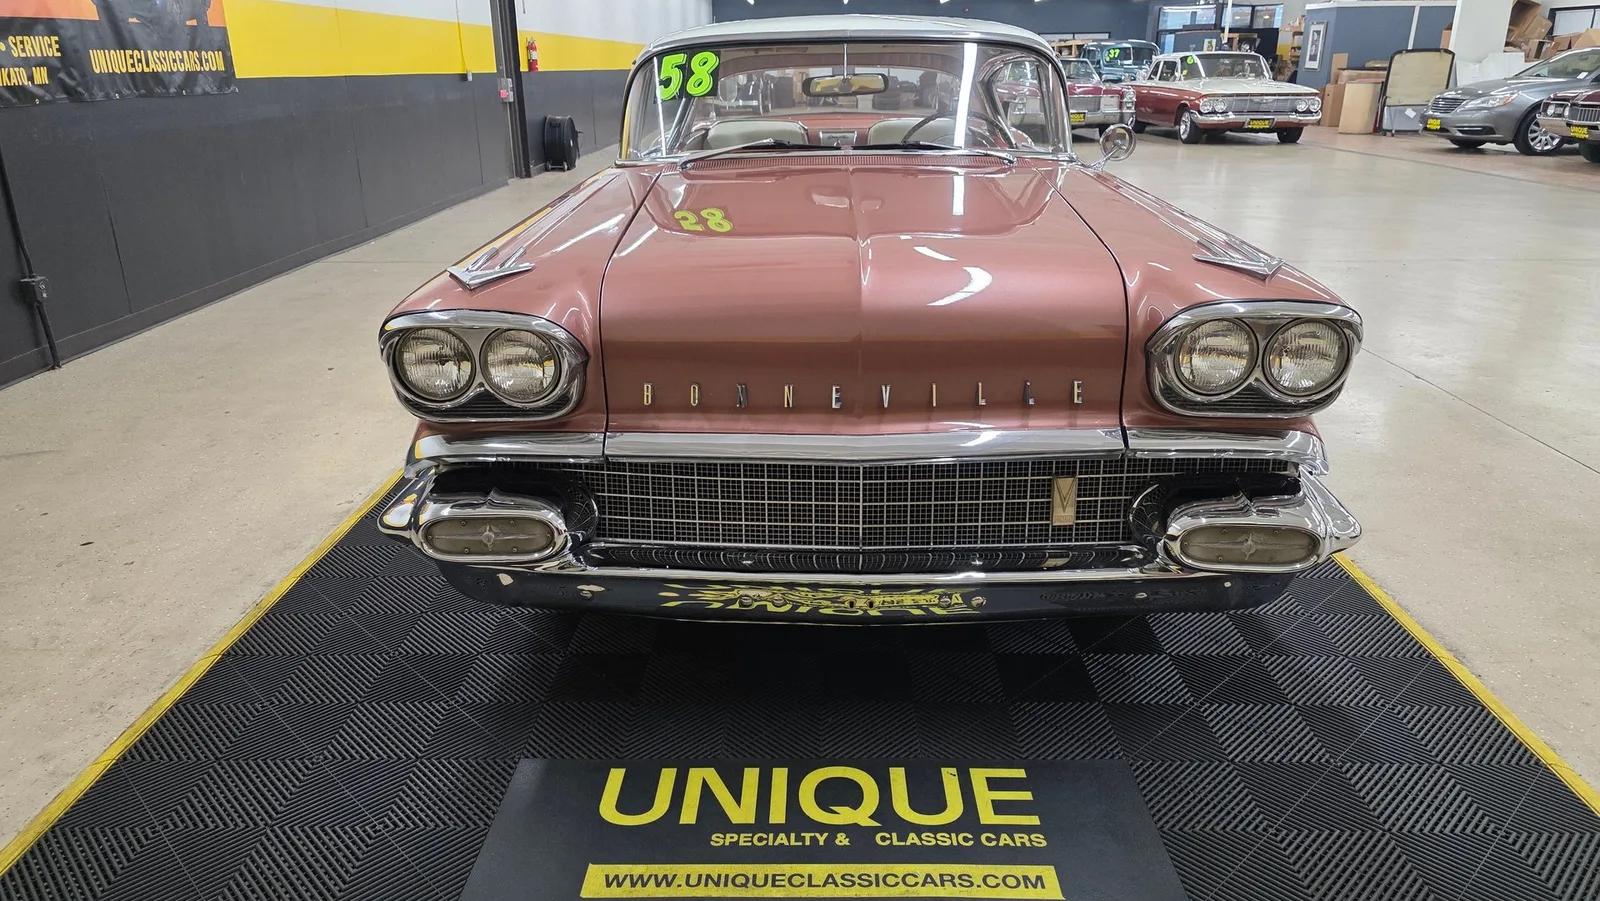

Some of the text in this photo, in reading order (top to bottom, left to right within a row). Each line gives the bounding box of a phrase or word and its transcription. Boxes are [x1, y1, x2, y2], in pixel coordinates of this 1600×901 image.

[8, 36, 61, 57] SERVICE
[1108, 48, 1120, 58] 37
[90, 49, 225, 74] UNIQUECLASSICCARS.COM
[33, 66, 48, 84] MN
[658, 50, 719, 101] 58
[643, 379, 1083, 409] BONNEVILLE
[598, 765, 1041, 827] UNIQUE
[710, 831, 1048, 849] SPECIALTY & CLASSIC CARS
[604, 873, 1046, 889] WWW.UNIQUECLASSICCARS.COM
